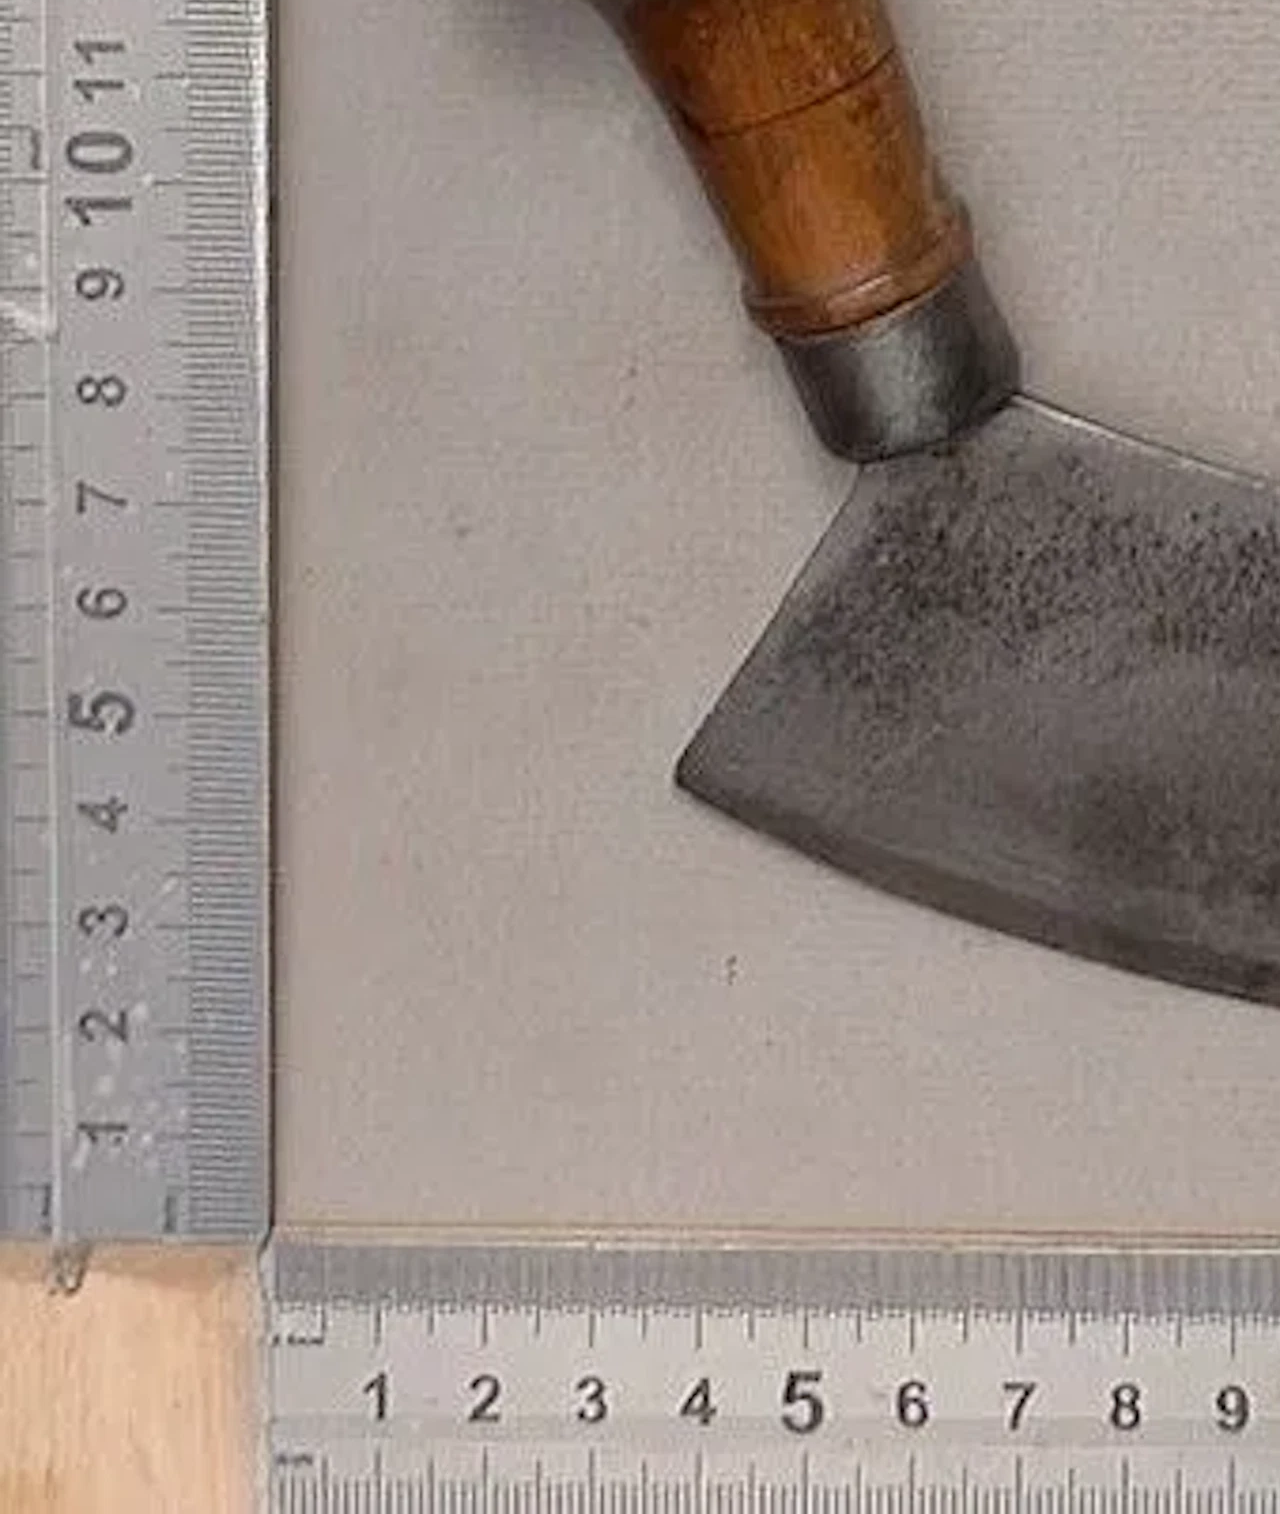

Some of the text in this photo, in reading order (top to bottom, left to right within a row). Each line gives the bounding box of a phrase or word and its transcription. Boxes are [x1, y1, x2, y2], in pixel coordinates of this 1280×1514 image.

[72, 40, 126, 103] 11
[63, 131, 134, 228] 10
[74, 267, 126, 302] 9
[75, 374, 129, 408] 8
[75, 479, 128, 516] 7
[75, 587, 129, 621] 6
[66, 691, 136, 736] 5
[76, 796, 129, 835] 4
[77, 904, 129, 939] 3
[77, 1009, 129, 1045] 2
[76, 1121, 130, 1146] 1
[362, 1371, 389, 1423] 1
[466, 1373, 502, 1425] 2
[575, 1375, 608, 1427] 3
[679, 1376, 718, 1428] 4
[780, 1369, 825, 1437] 5
[895, 1378, 930, 1433] 6
[1002, 1381, 1038, 1433] 7
[1108, 1382, 1142, 1433] 8
[1215, 1384, 1250, 1435] 9
